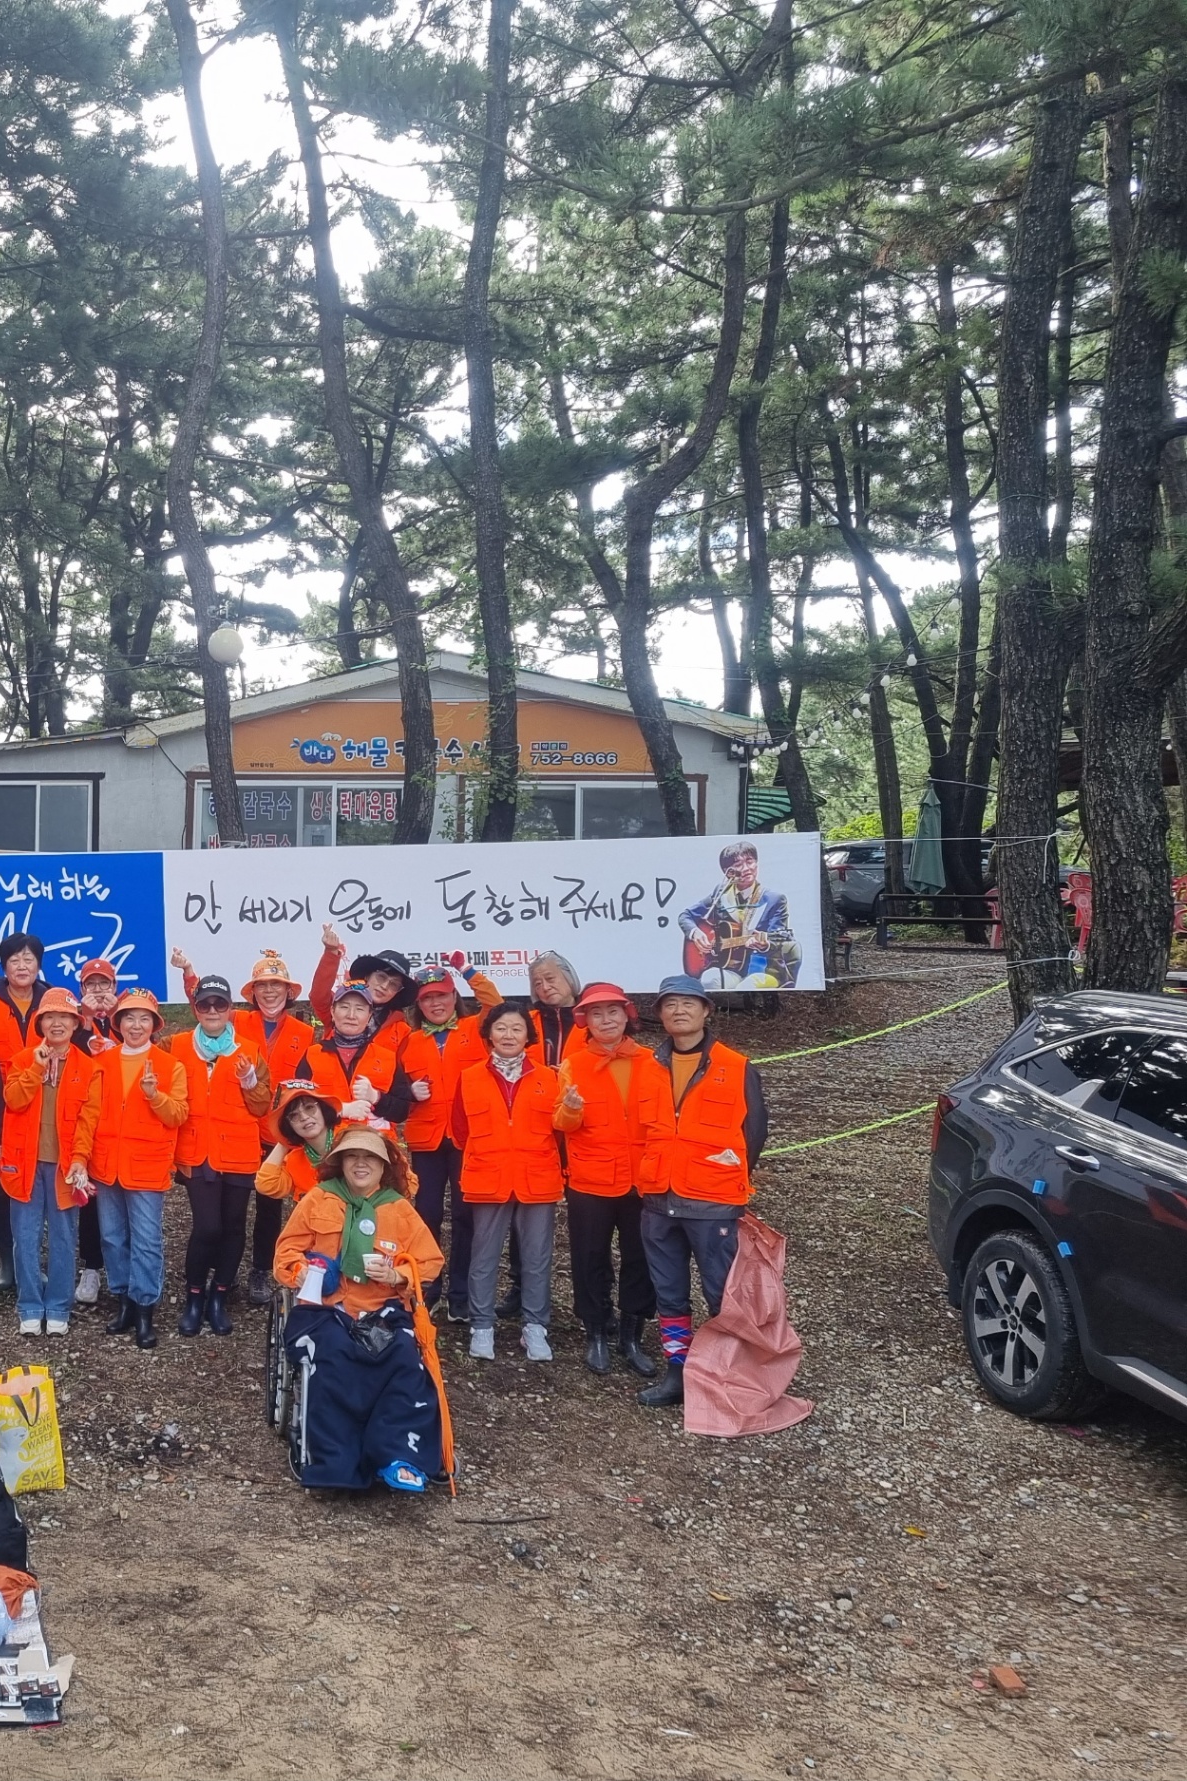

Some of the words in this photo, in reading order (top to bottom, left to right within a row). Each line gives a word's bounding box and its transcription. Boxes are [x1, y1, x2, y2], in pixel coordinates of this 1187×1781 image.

[530, 751, 618, 766] 752-8666
[184, 879, 222, 935] 안
[238, 895, 312, 924] 버리기
[328, 879, 411, 933] 운동에
[201, 981, 228, 992] adidas
[29, 1422, 53, 1440] CLEAN
[27, 1431, 54, 1450] WATER
[21, 1465, 59, 1487] SAVE
